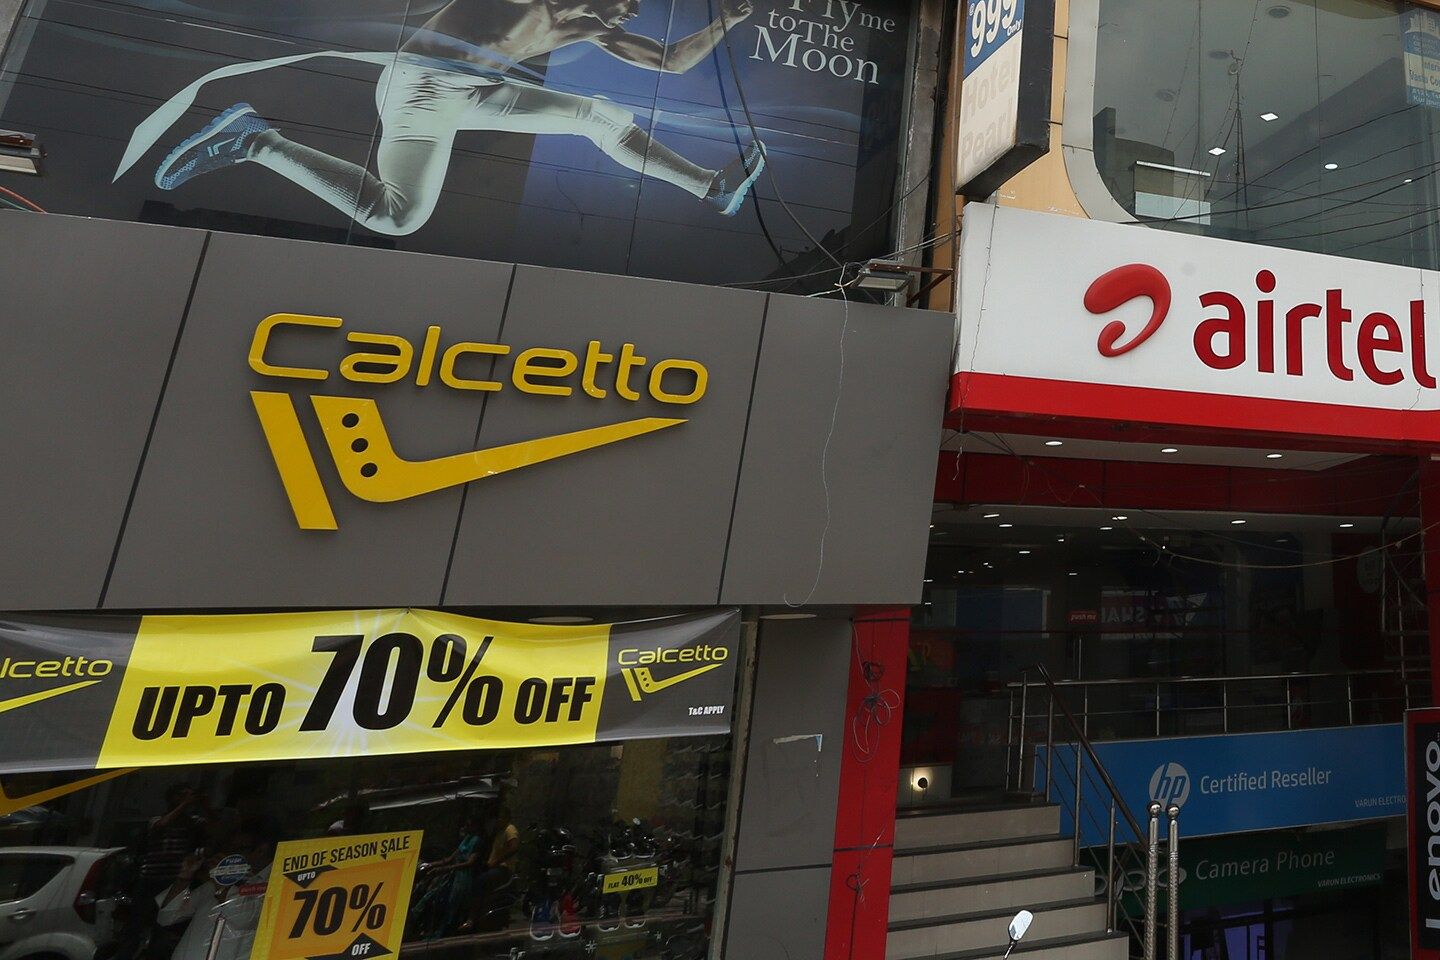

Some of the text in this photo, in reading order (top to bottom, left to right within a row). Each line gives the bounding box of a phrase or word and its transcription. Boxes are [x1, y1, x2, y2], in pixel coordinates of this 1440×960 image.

[859, 12, 896, 33] me
[748, 25, 879, 85] Moon
[1193, 269, 1437, 390] airtel
[247, 311, 710, 406] Calcetto
[618, 644, 729, 666] Calcetto
[130, 632, 596, 741] UPTO 70% OFF
[688, 705, 725, 716] T&C APPLY
[1153, 763, 1186, 809] hp
[1200, 767, 1332, 795] Certified Reseller
[1354, 796, 1378, 808] VARUN
[282, 835, 411, 873] END OF SEASON SALE
[1195, 848, 1336, 881] Camera Phone
[297, 871, 316, 882] UPTO
[621, 872, 644, 888] 40%
[1317, 872, 1382, 888] VARUN ELECTRONICS
[288, 881, 387, 940] 70%
[351, 942, 372, 956] OFF
